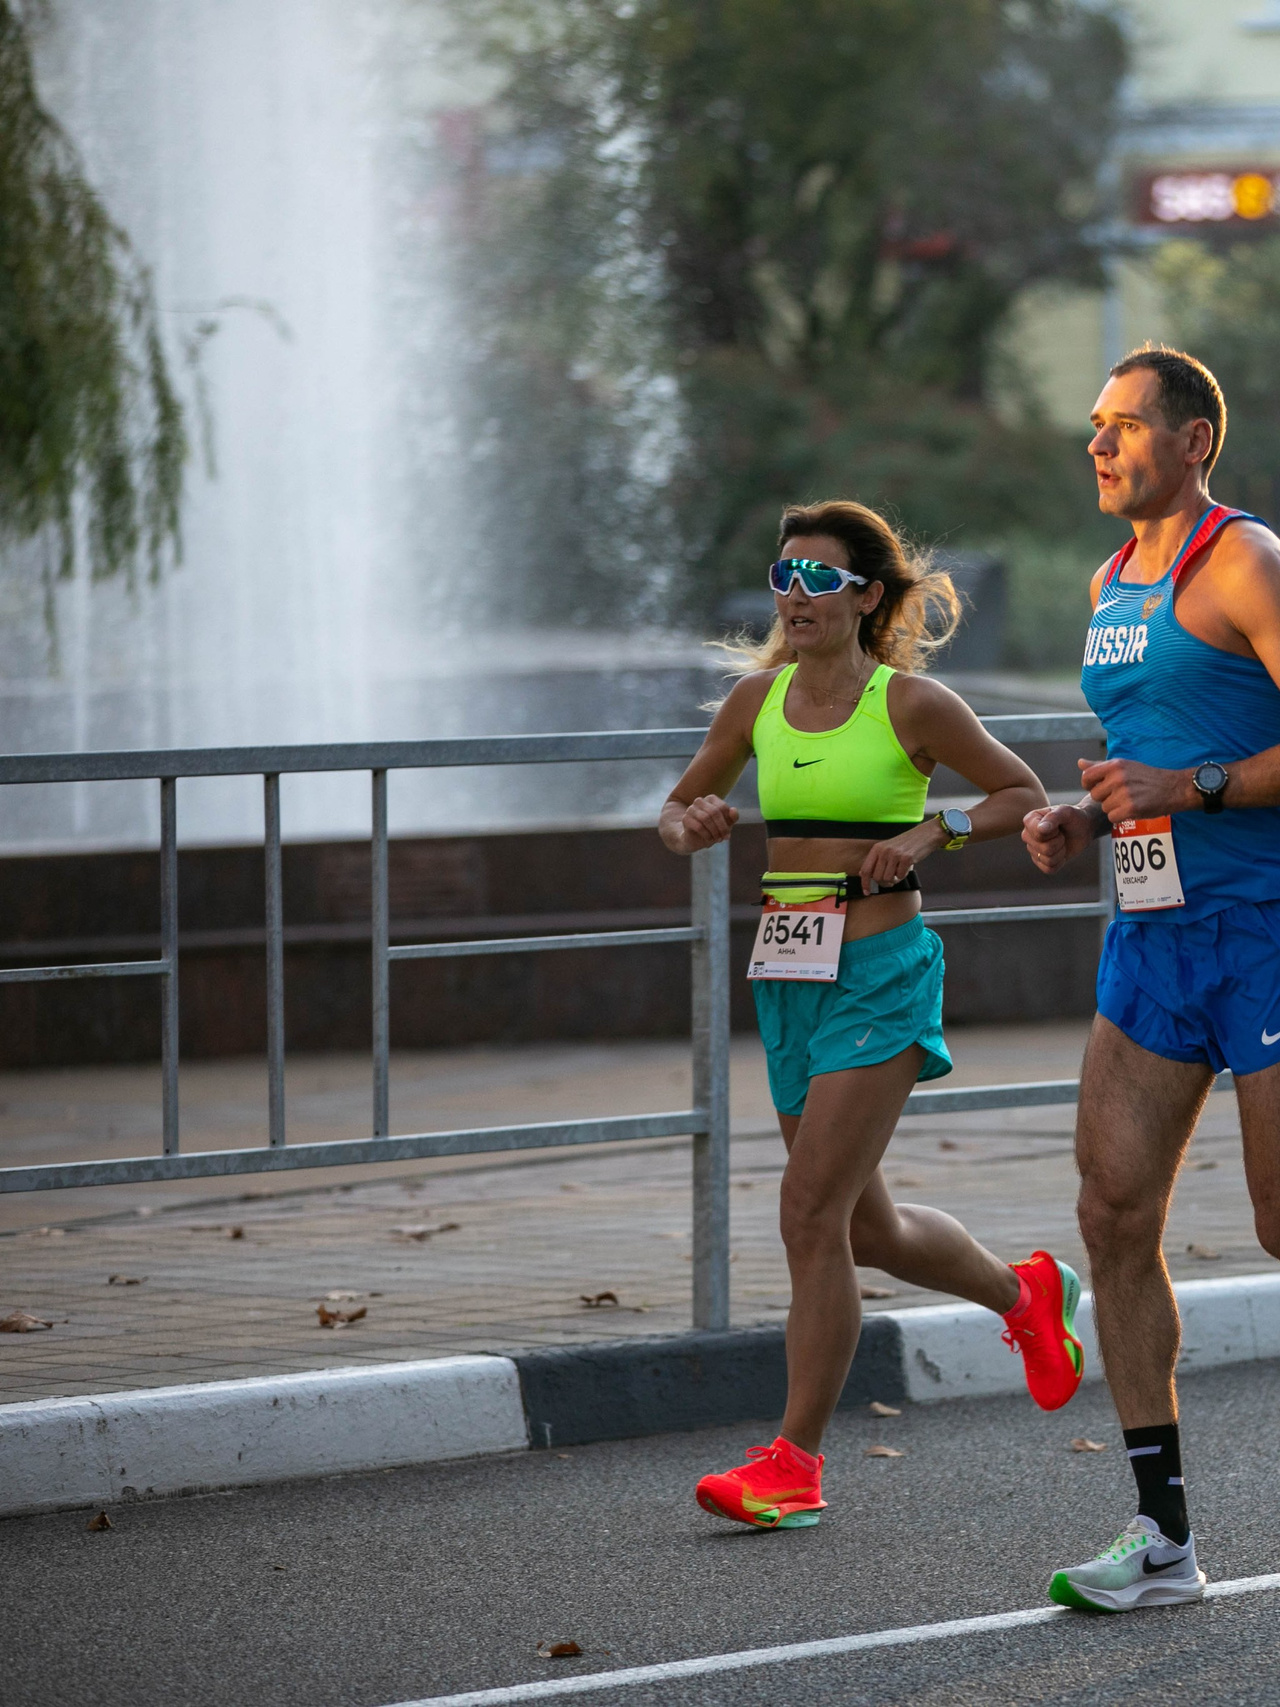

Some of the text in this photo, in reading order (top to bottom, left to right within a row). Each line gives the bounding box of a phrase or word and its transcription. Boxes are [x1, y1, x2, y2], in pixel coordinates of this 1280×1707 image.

[1115, 838, 1166, 874] 6806
[1122, 875, 1148, 885] АЛЕКСАНДР
[763, 914, 825, 946] 6541
